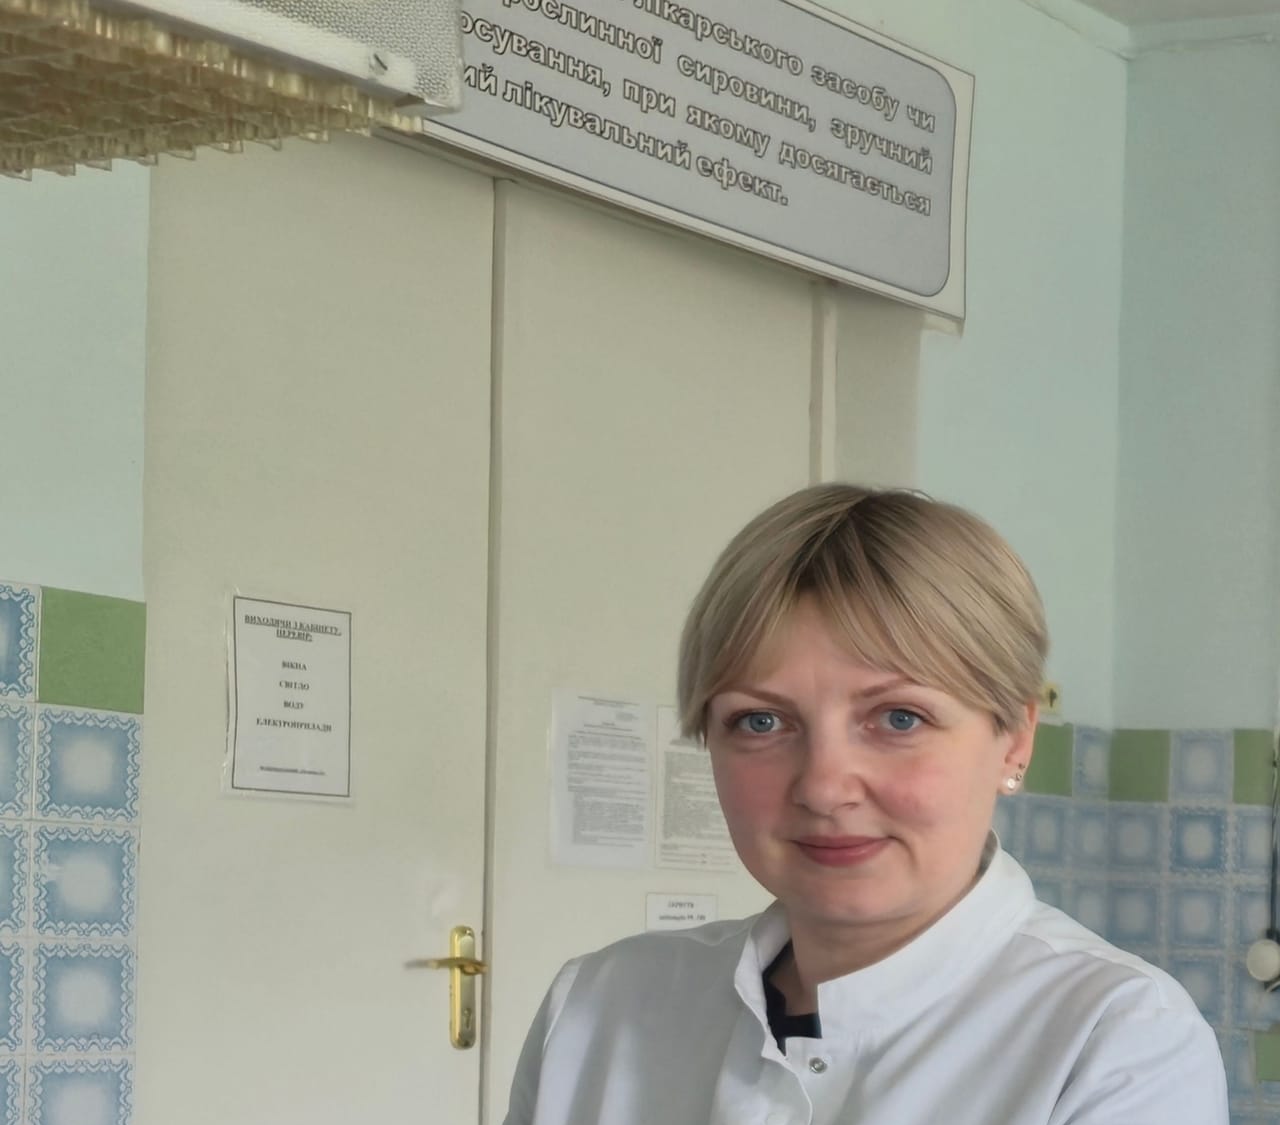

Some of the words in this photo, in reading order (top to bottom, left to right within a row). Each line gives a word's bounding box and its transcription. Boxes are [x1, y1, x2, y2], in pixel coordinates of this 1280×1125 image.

[461, 11, 611, 96] осування,
[624, 78, 676, 118] при
[687, 108, 770, 157] якому
[780, 142, 931, 216] досягається
[464, 63, 498, 96] ий
[502, 82, 692, 170] лікувальний
[698, 155, 789, 206] ефект.
[677, 55, 816, 130] сировини,
[831, 117, 933, 174] зручний
[811, 62, 899, 121] засобу
[907, 104, 936, 134] чи
